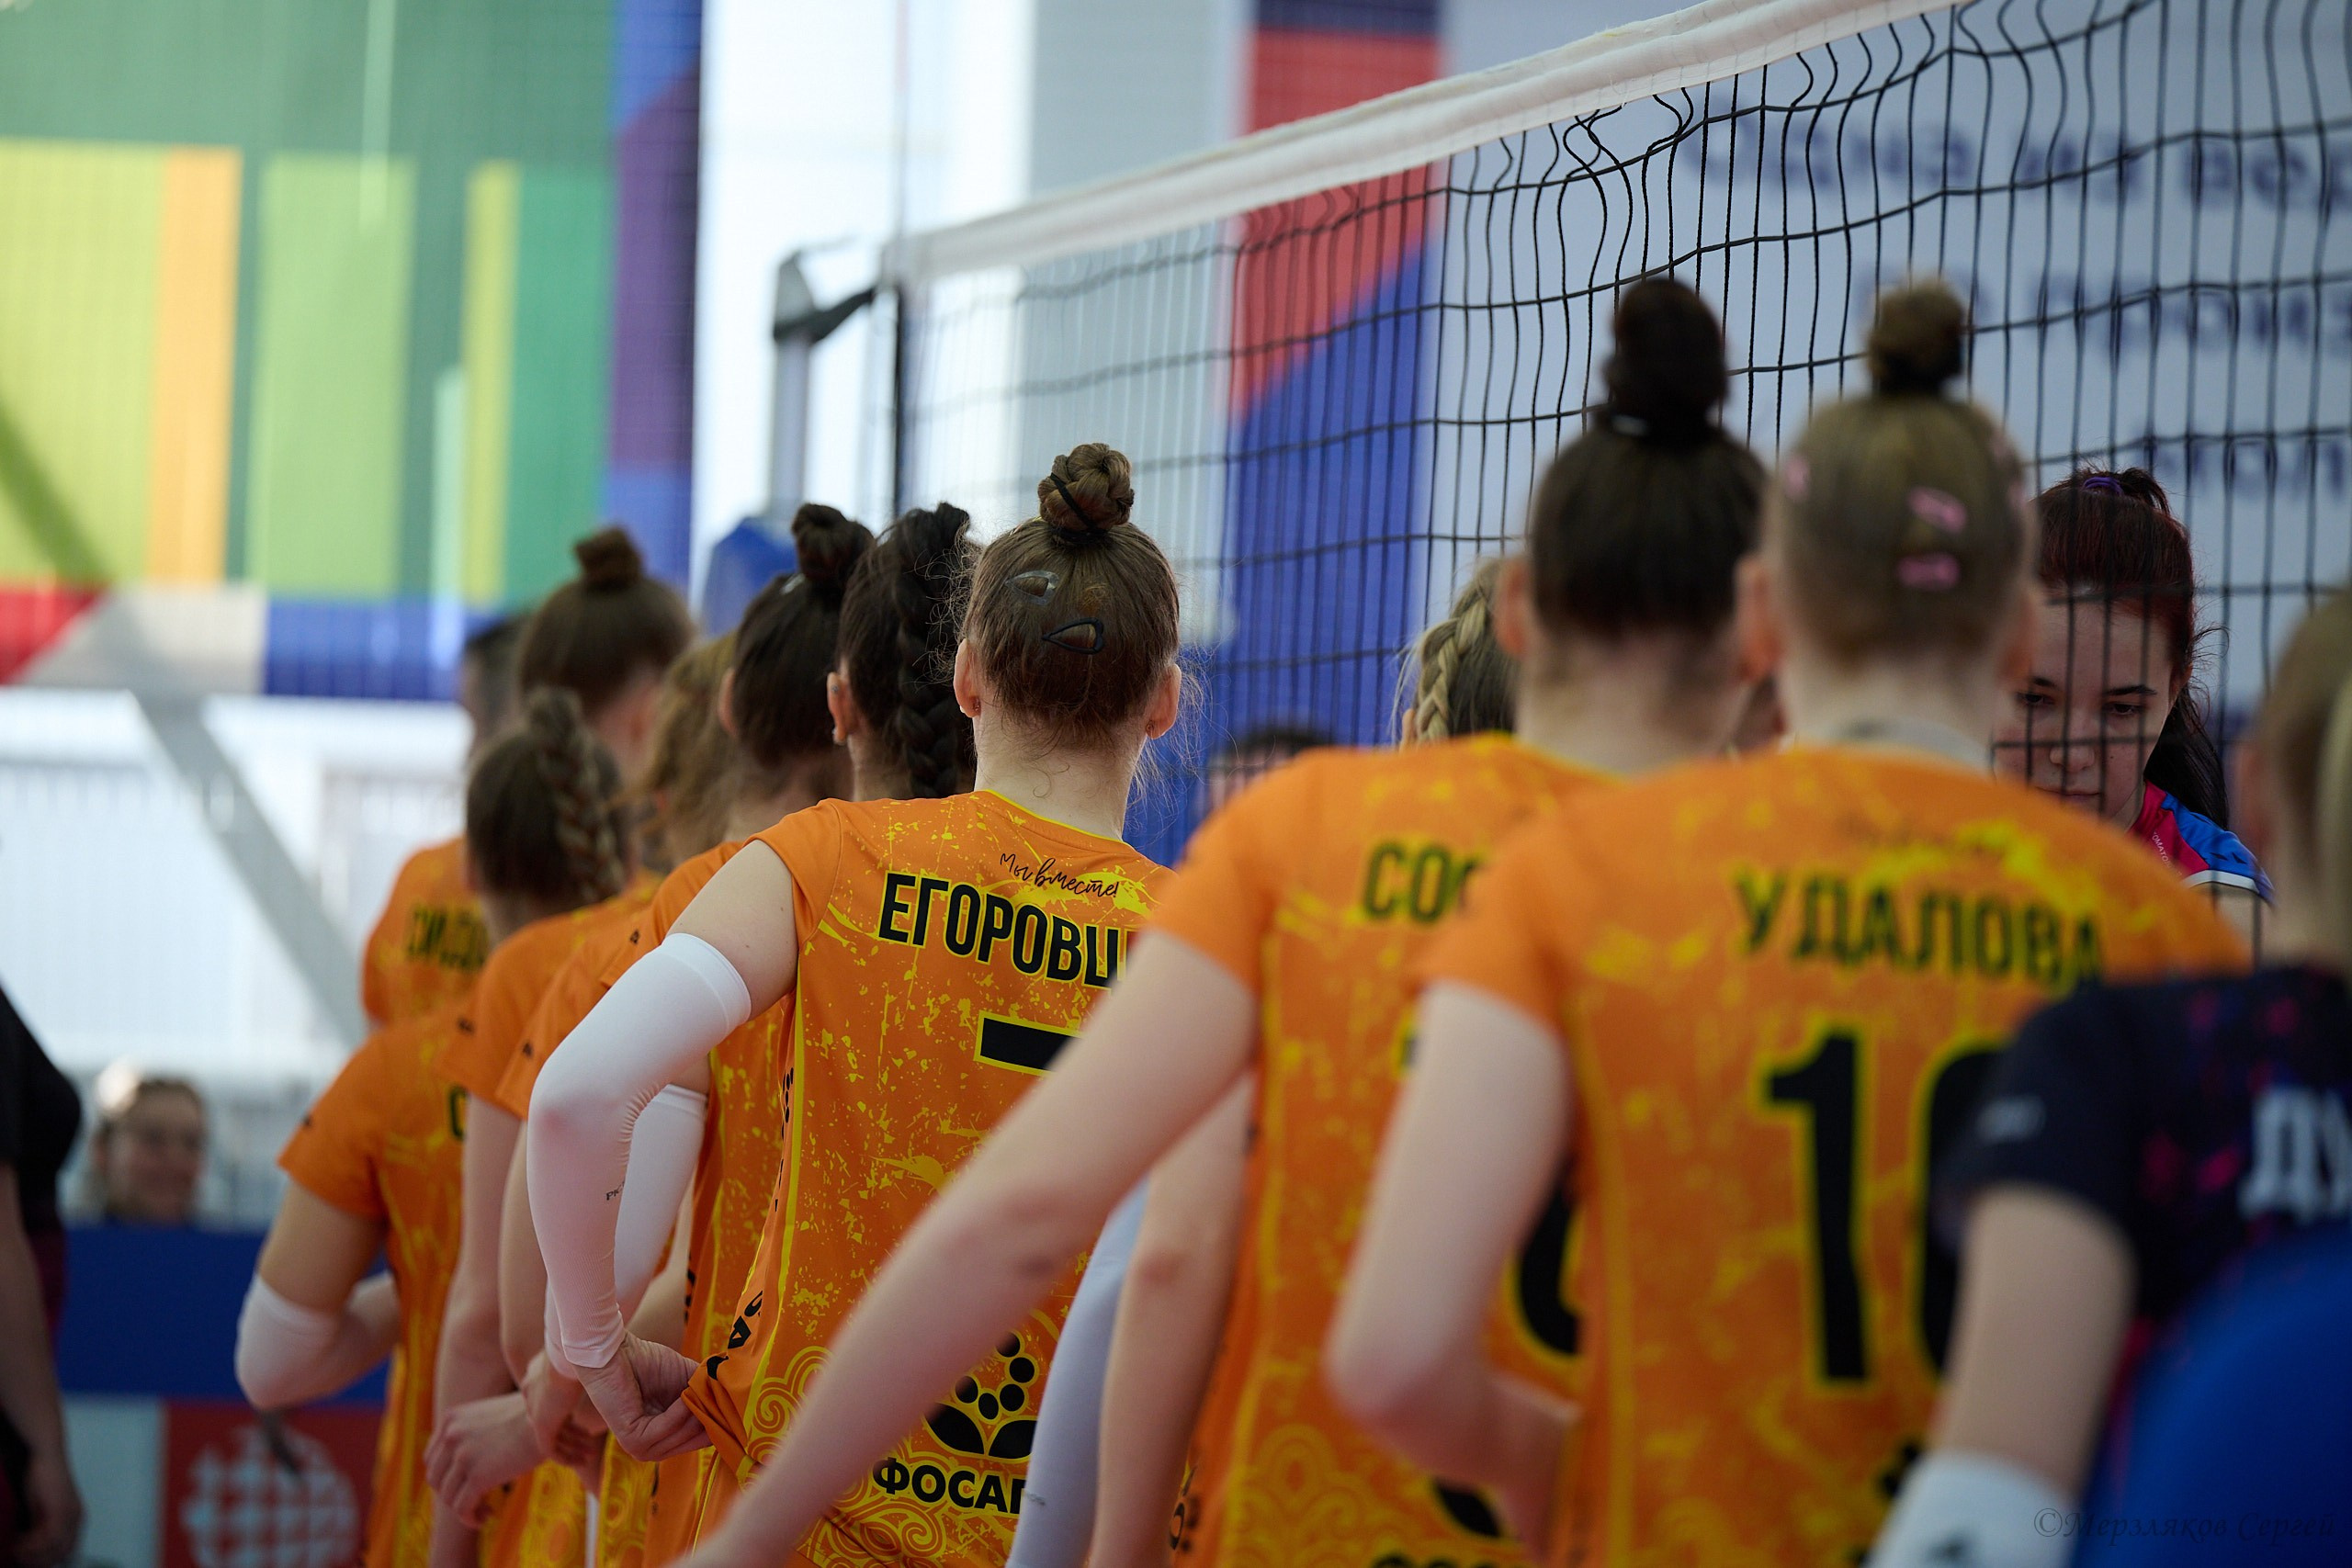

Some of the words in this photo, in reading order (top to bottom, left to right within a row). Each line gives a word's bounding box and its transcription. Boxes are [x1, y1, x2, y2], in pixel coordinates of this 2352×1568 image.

[876, 871, 1137, 992] ЕГОРОВЦ
[1000, 852, 1034, 881] Мы
[1035, 857, 1119, 898] вместе!
[1733, 869, 2108, 987] УДАЛОВА
